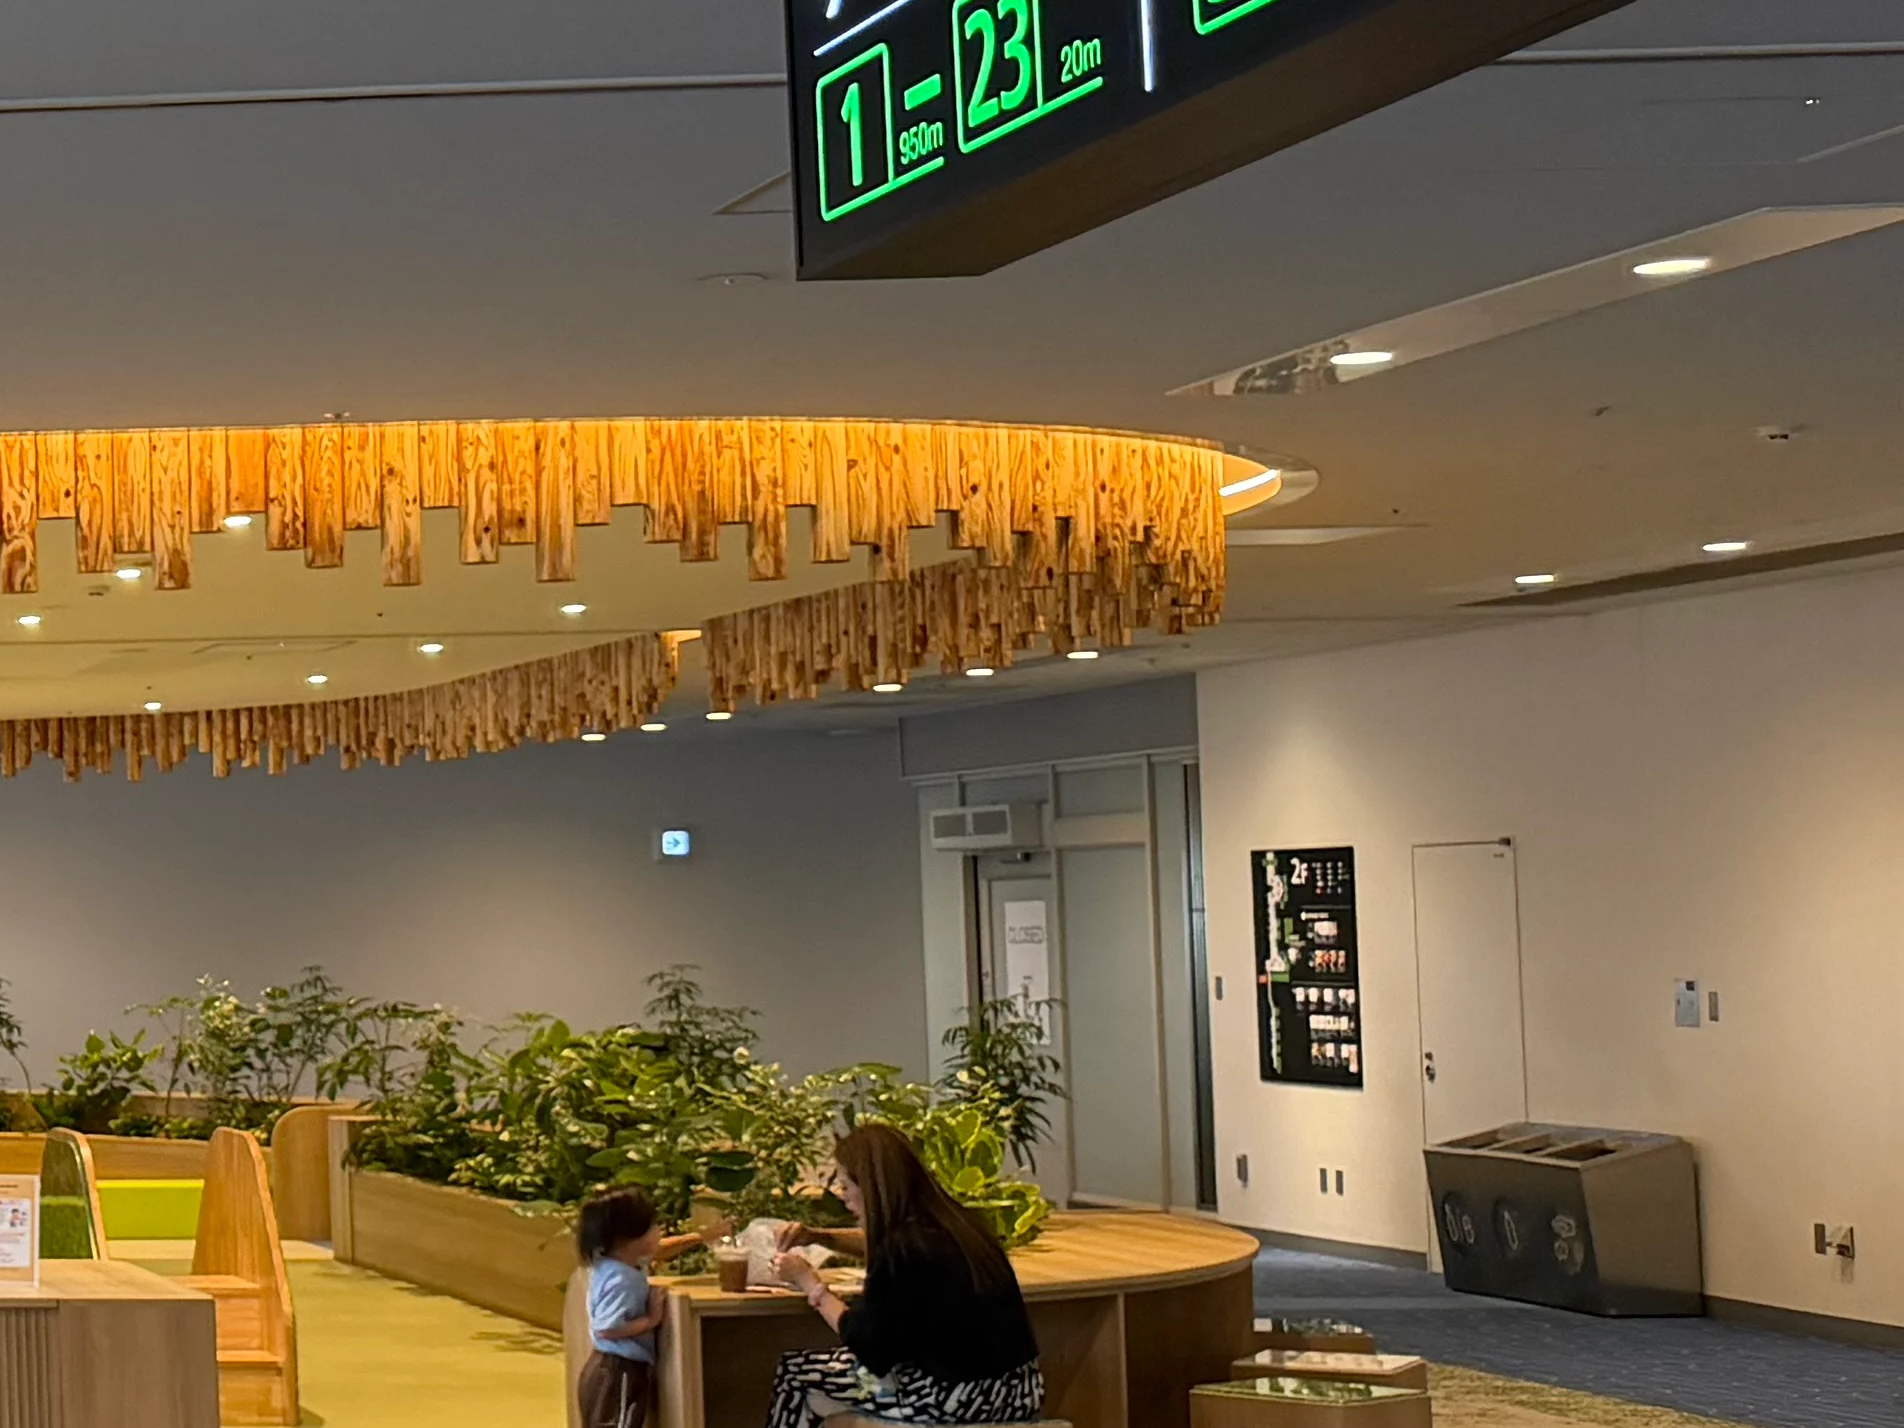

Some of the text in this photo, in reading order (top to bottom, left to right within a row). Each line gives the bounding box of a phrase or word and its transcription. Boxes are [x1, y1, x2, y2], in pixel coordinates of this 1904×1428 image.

[841, 82, 863, 187] 1
[1060, 38, 1101, 84] 20m
[899, 121, 944, 165] 950m
[1290, 857, 1308, 884] 2F
